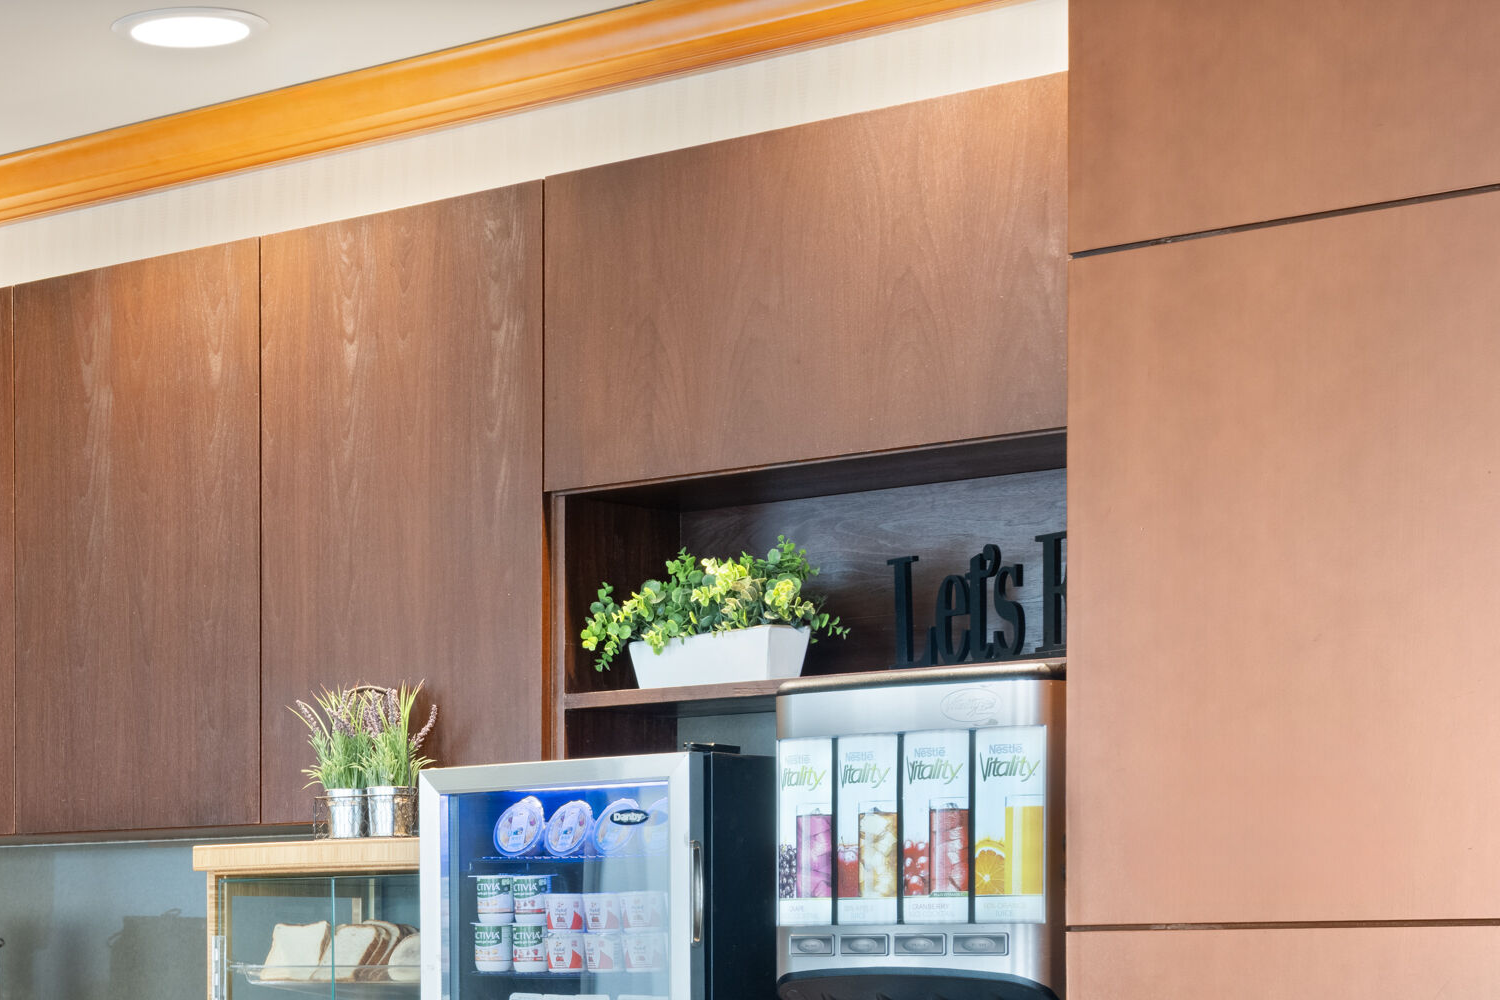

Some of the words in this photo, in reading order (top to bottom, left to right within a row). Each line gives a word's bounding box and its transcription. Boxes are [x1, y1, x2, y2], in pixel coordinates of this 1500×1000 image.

[887, 544, 1026, 672] Let's
[914, 747, 946, 757] Nestlé
[989, 744, 1023, 754] Nestlé
[906, 756, 964, 784] Vitality
[980, 752, 1040, 782] Vitality
[780, 763, 827, 791] Vitality
[840, 760, 891, 788] Vitality
[613, 812, 643, 822] Danby
[477, 883, 500, 891] CTIVIA
[513, 883, 538, 891] CTIVIA
[475, 931, 500, 939] CTIVIA
[513, 931, 540, 940] CTIVIA
